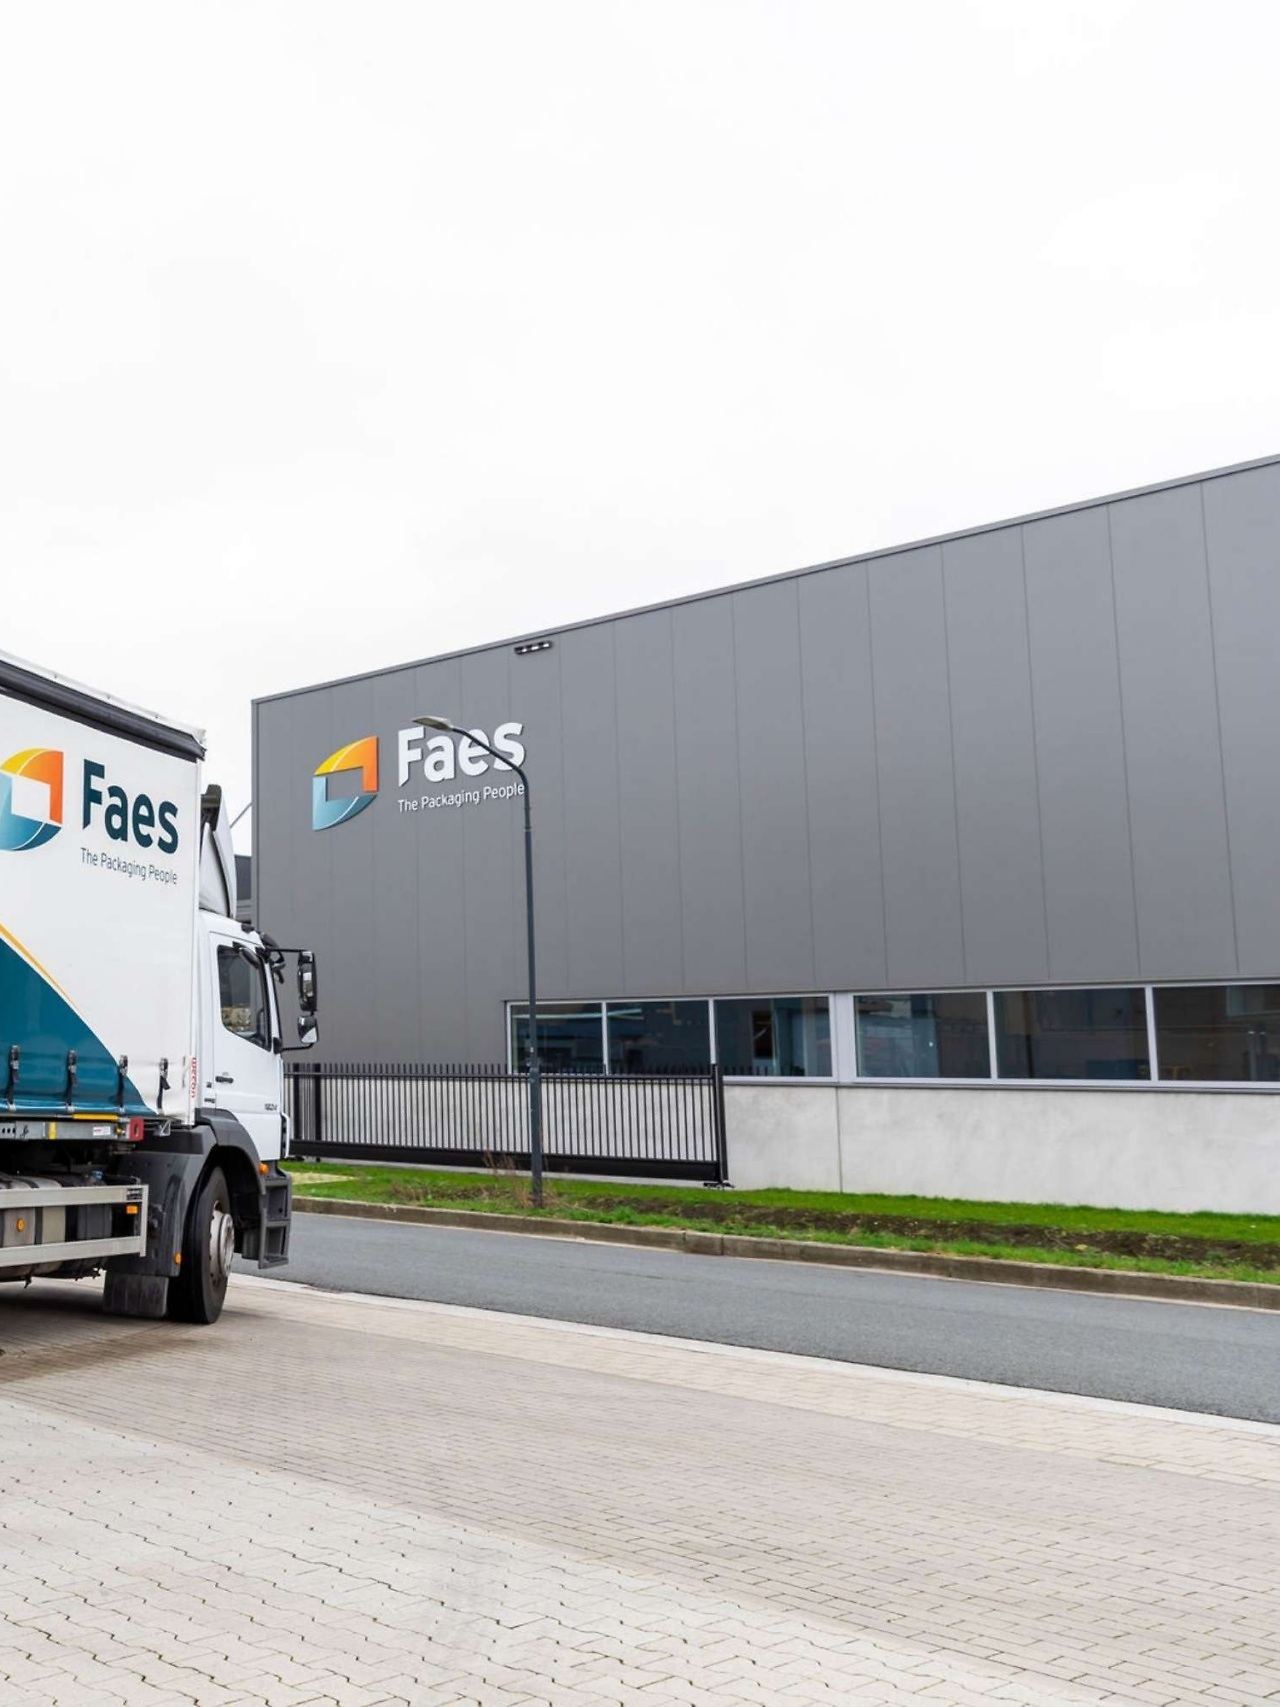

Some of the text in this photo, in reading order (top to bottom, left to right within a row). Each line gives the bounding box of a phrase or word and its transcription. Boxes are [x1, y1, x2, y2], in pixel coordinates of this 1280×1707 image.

[398, 722, 525, 787] Faes
[82, 758, 179, 854] Faes
[397, 782, 526, 813] The Packaging People
[80, 847, 178, 886] The Packaging People
